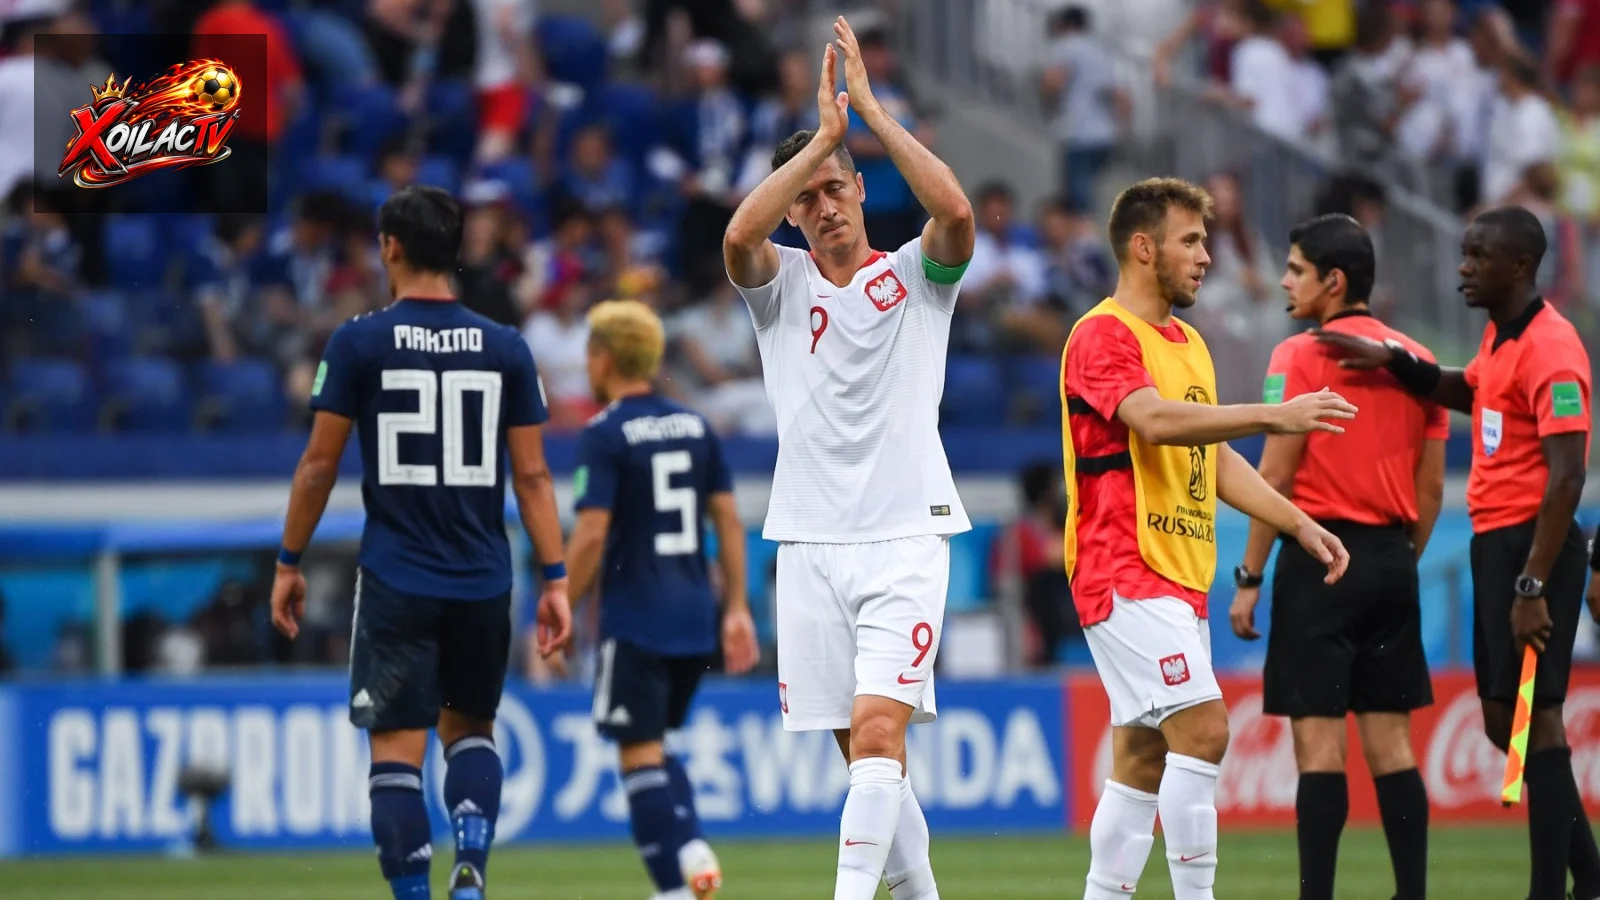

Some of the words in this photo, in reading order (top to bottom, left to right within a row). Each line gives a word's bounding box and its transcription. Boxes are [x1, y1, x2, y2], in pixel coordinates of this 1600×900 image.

[393, 324, 484, 353] MAKINO
[810, 305, 829, 354] 9
[377, 368, 502, 487] 20
[650, 449, 698, 555] 5
[1147, 512, 1204, 541] RUSSIA
[911, 621, 934, 668] 9
